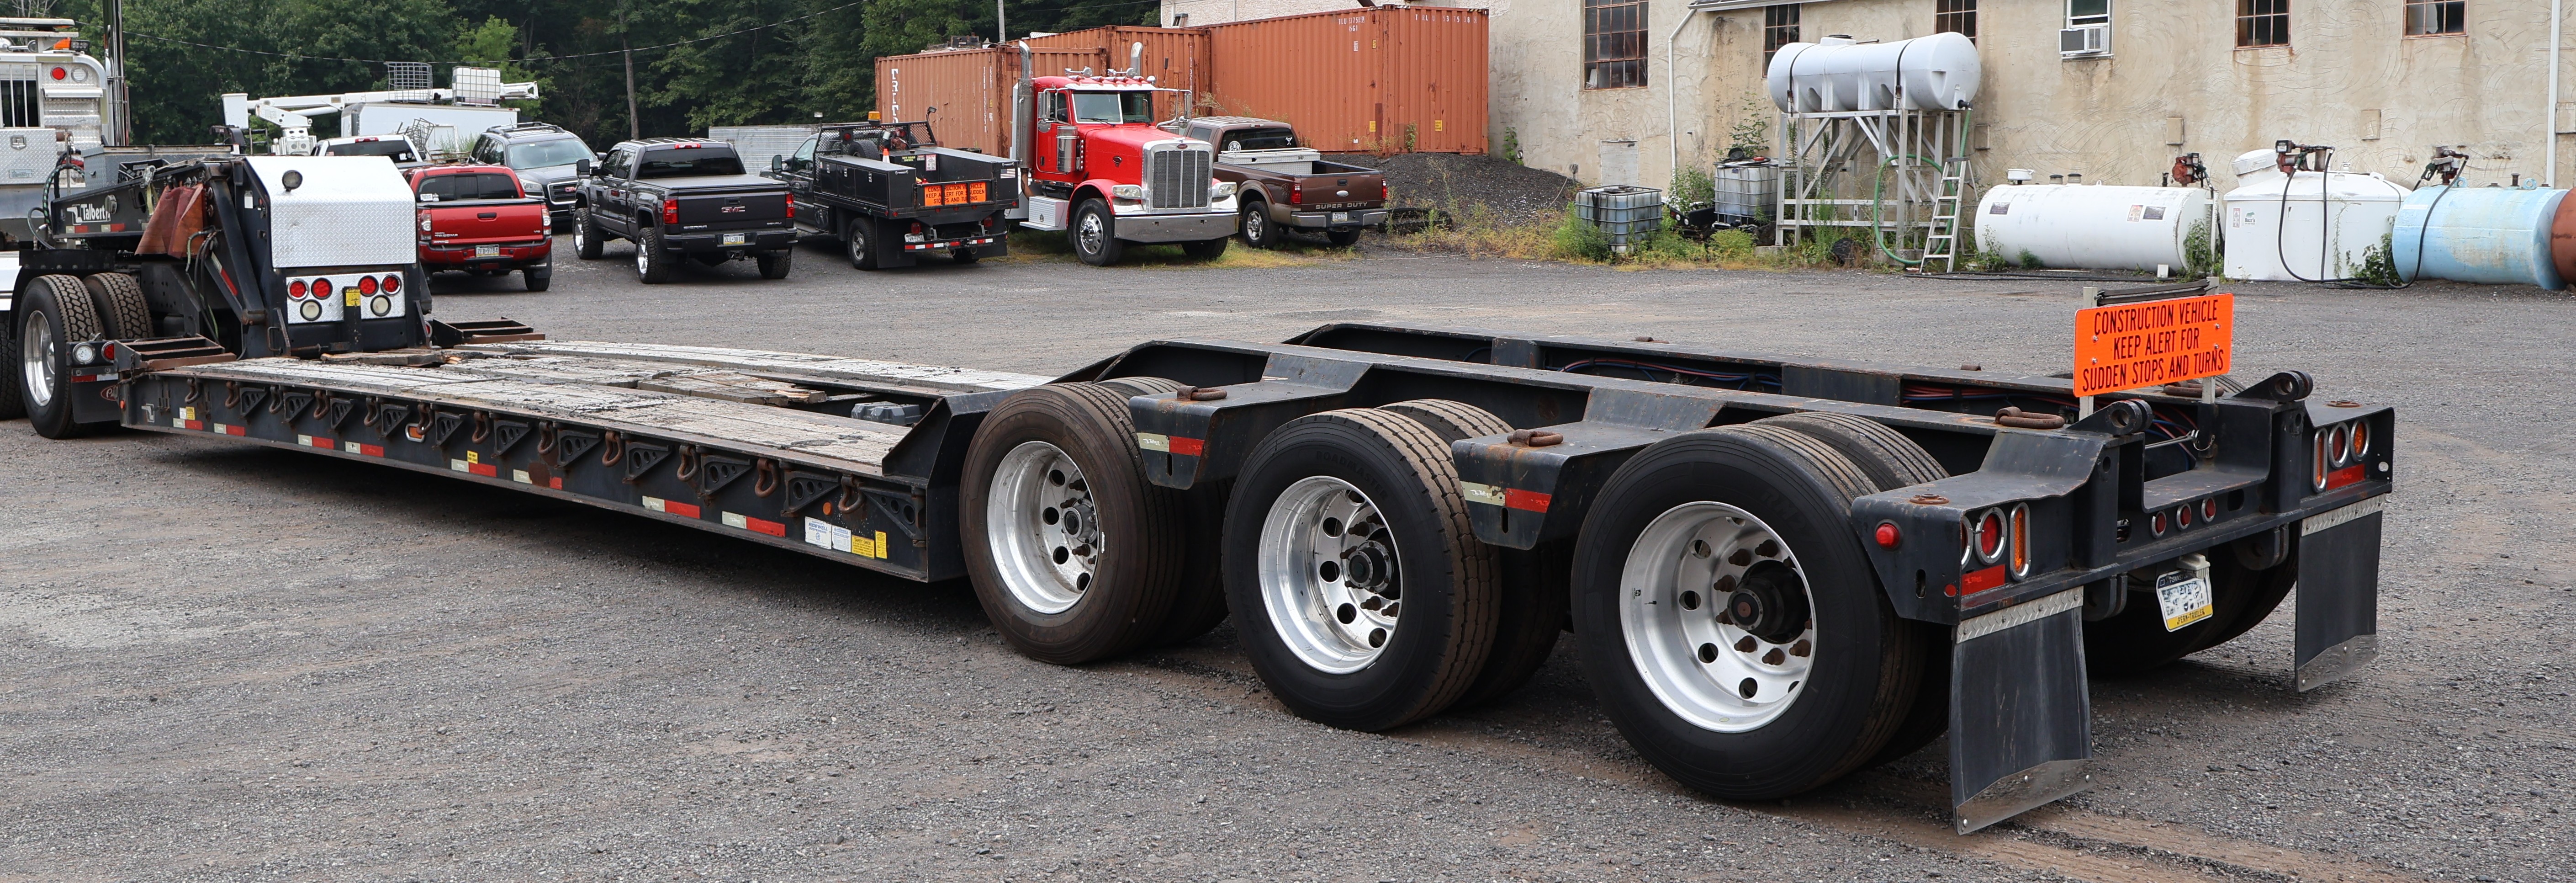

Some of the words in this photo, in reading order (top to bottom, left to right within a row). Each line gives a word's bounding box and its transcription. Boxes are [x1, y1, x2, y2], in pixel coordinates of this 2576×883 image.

[80, 203, 106, 221] Talbert
[2094, 304, 2174, 335] CONSTRUCTION
[2179, 299, 2218, 325] VEHICLE
[2114, 335, 2141, 360] KEEP
[2145, 330, 2176, 356] ALERT
[2181, 327, 2200, 351] FOR
[2083, 364, 2126, 392] SUDDEN
[2132, 358, 2164, 384] STOPS
[2169, 354, 2189, 378] AND
[2194, 349, 2224, 375] TURNS
[1316, 450, 1389, 501] ROADMASTER
[809, 522, 828, 531] RIDEWELL
